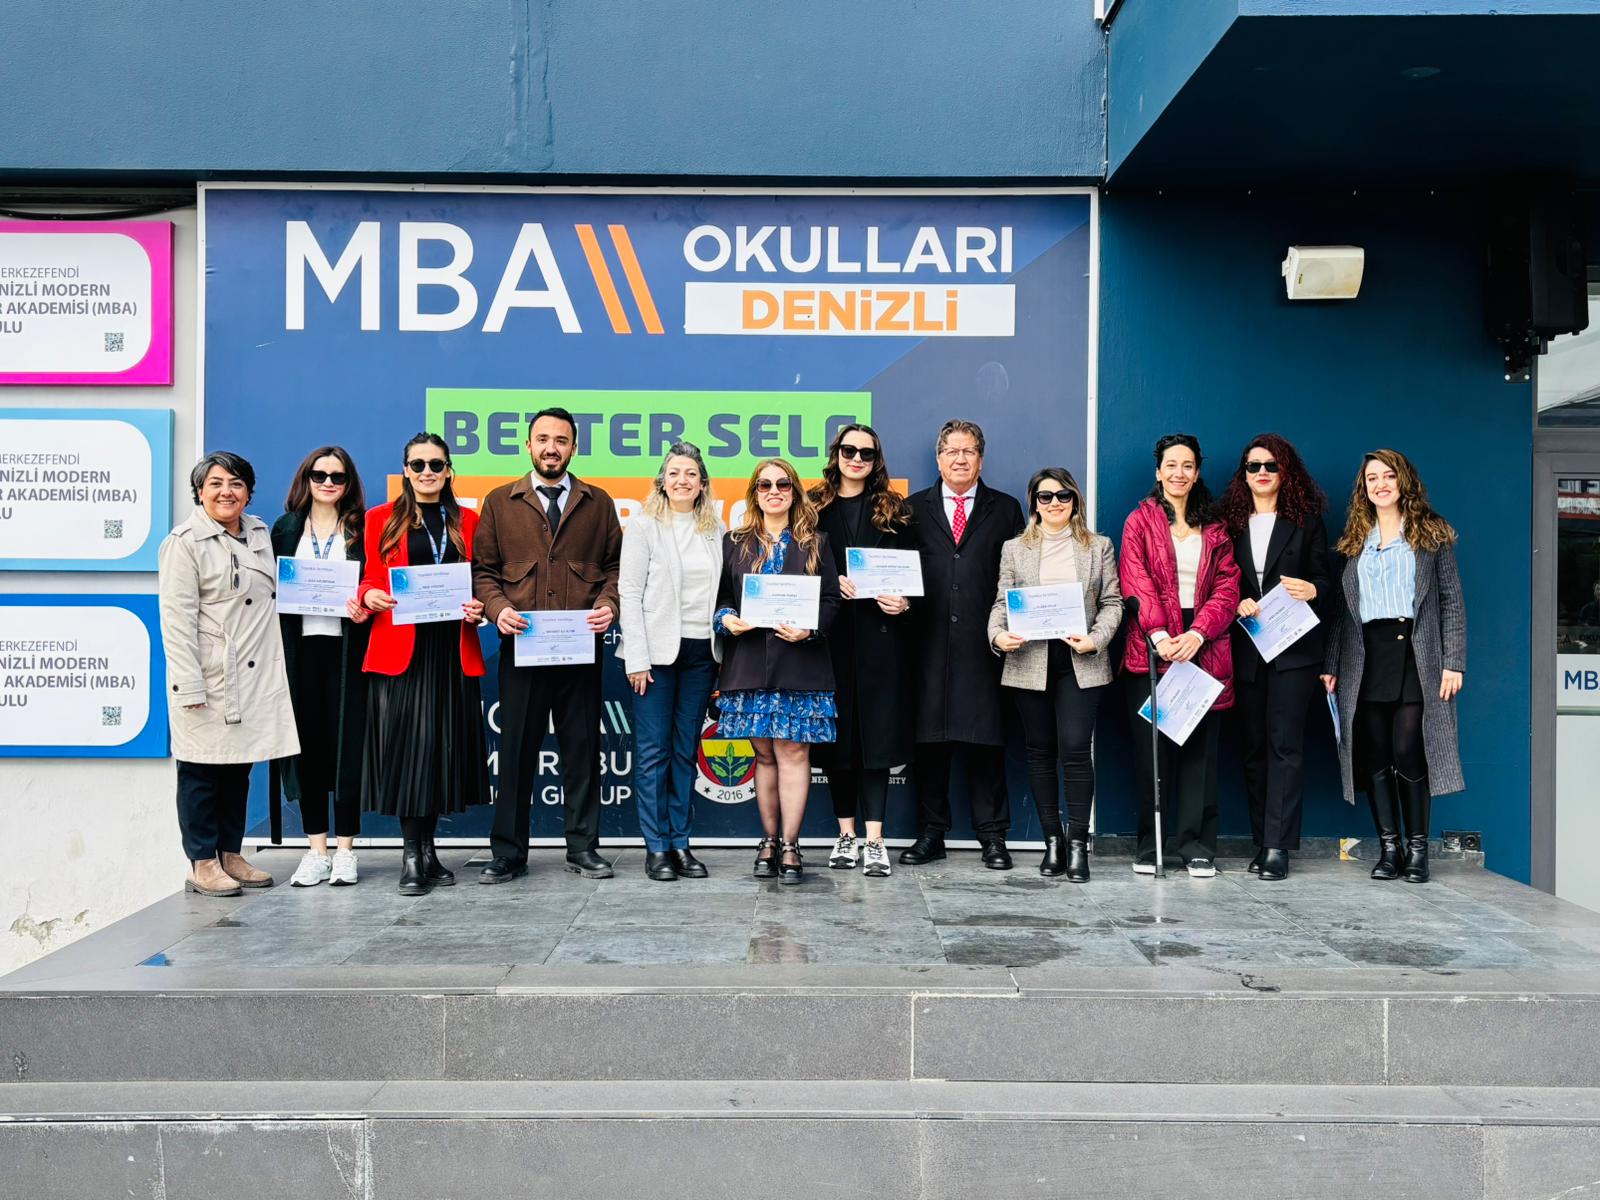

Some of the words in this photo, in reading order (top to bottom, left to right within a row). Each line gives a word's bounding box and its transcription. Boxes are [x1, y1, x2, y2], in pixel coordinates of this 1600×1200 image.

[683, 225, 1013, 273] OKULLARI
[1, 265, 80, 279] ERKEZEFENDİ
[286, 221, 583, 333] MBA
[0, 281, 38, 297] NİZLİ
[42, 283, 111, 297] MODERN
[6, 299, 89, 315] AKADEMİSİ
[92, 301, 137, 317] (MBA)
[442, 410, 686, 459] BETER
[0, 452, 80, 466] ERKEZEFENDİ
[0, 467, 38, 483] NİZLİ
[42, 470, 111, 484] MODERN
[7, 486, 89, 502] AKADEMİSİ
[92, 489, 137, 504] (MBA)
[0, 639, 78, 652] ERKEZEFENDİ
[0, 654, 35, 670] NİZLİ
[39, 656, 109, 670] MODERN
[4, 673, 87, 689] AKADEMİSİ
[90, 675, 136, 690] (MBA)
[1564, 670, 1600, 691] MB
[0, 694, 28, 707] ULU
[541, 785, 632, 806] GUP
[716, 789, 743, 801] 2016
